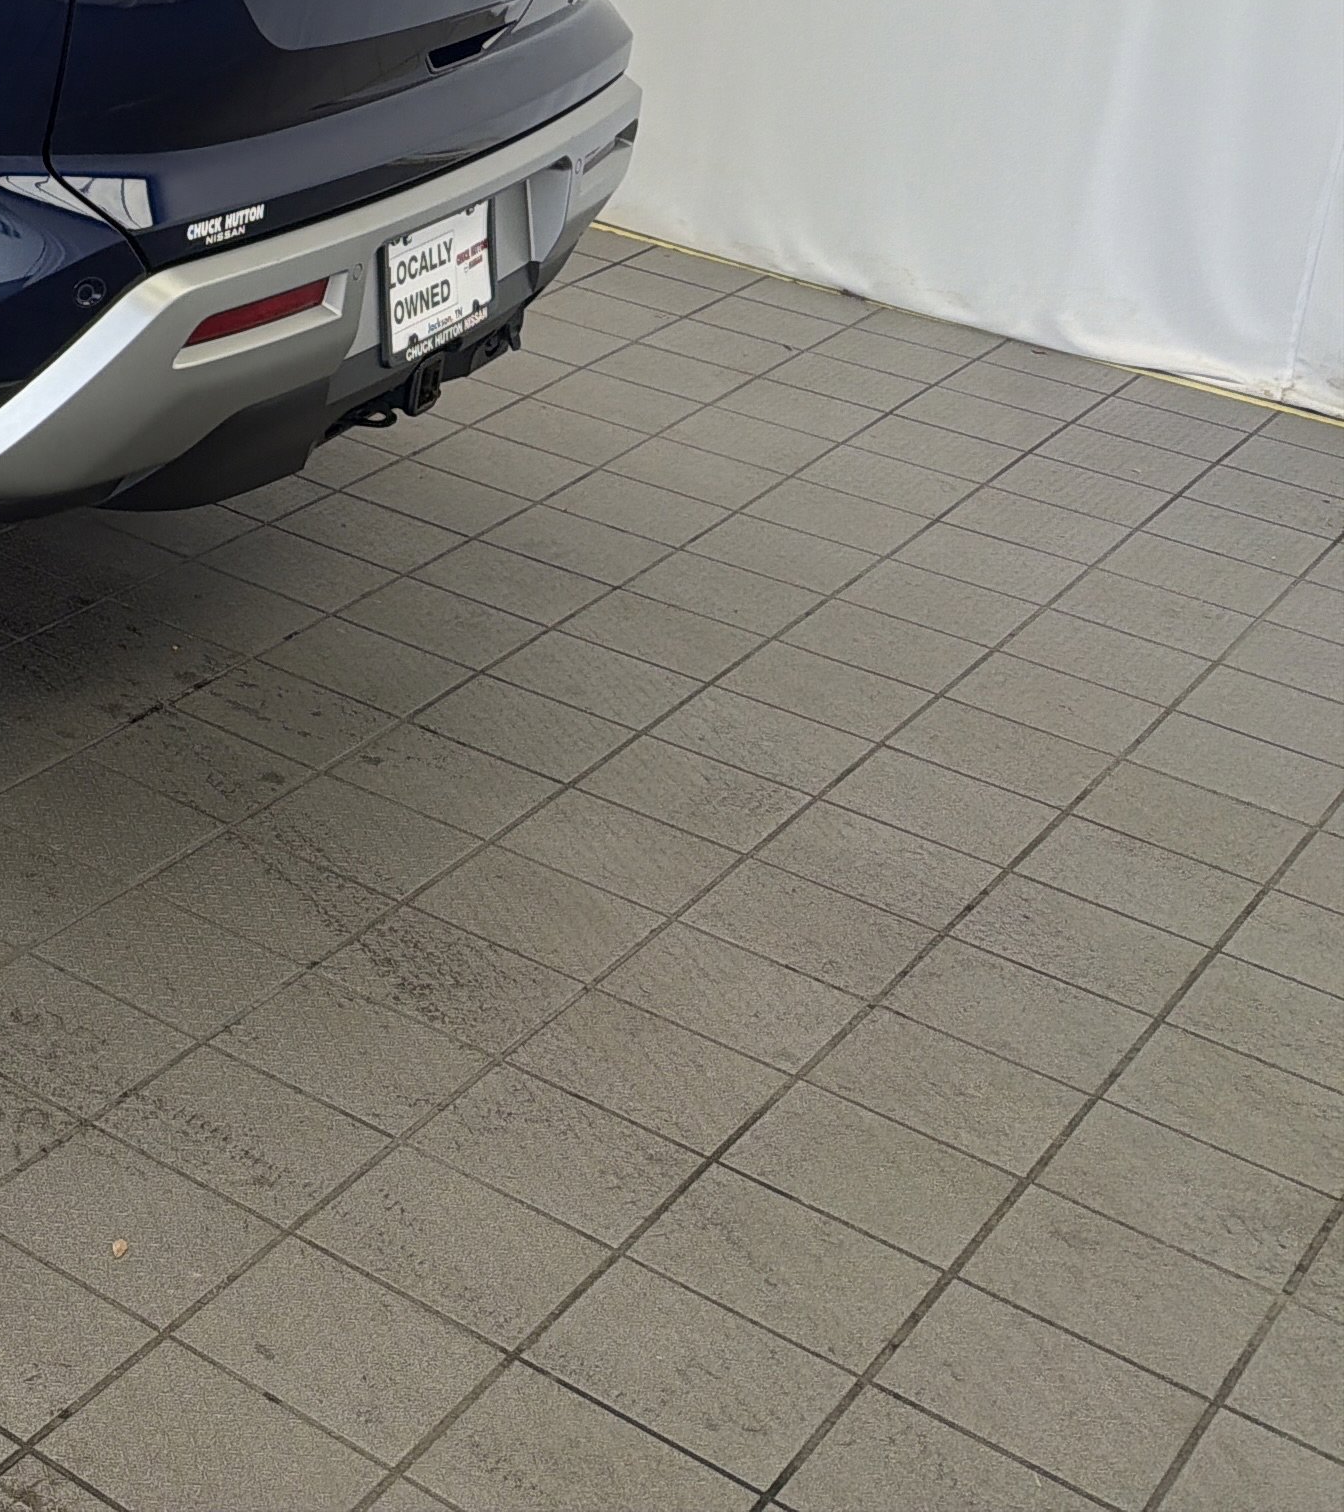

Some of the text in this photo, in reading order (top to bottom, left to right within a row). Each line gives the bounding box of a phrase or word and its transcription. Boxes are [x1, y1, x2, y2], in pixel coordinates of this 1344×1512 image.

[187, 204, 265, 240] CHUCK HUTTON
[206, 225, 246, 245] NISSAN
[389, 238, 453, 289] LOCALLY
[394, 279, 451, 325] OWNED
[406, 307, 488, 361] CHUCK HUTTON NISSAN
